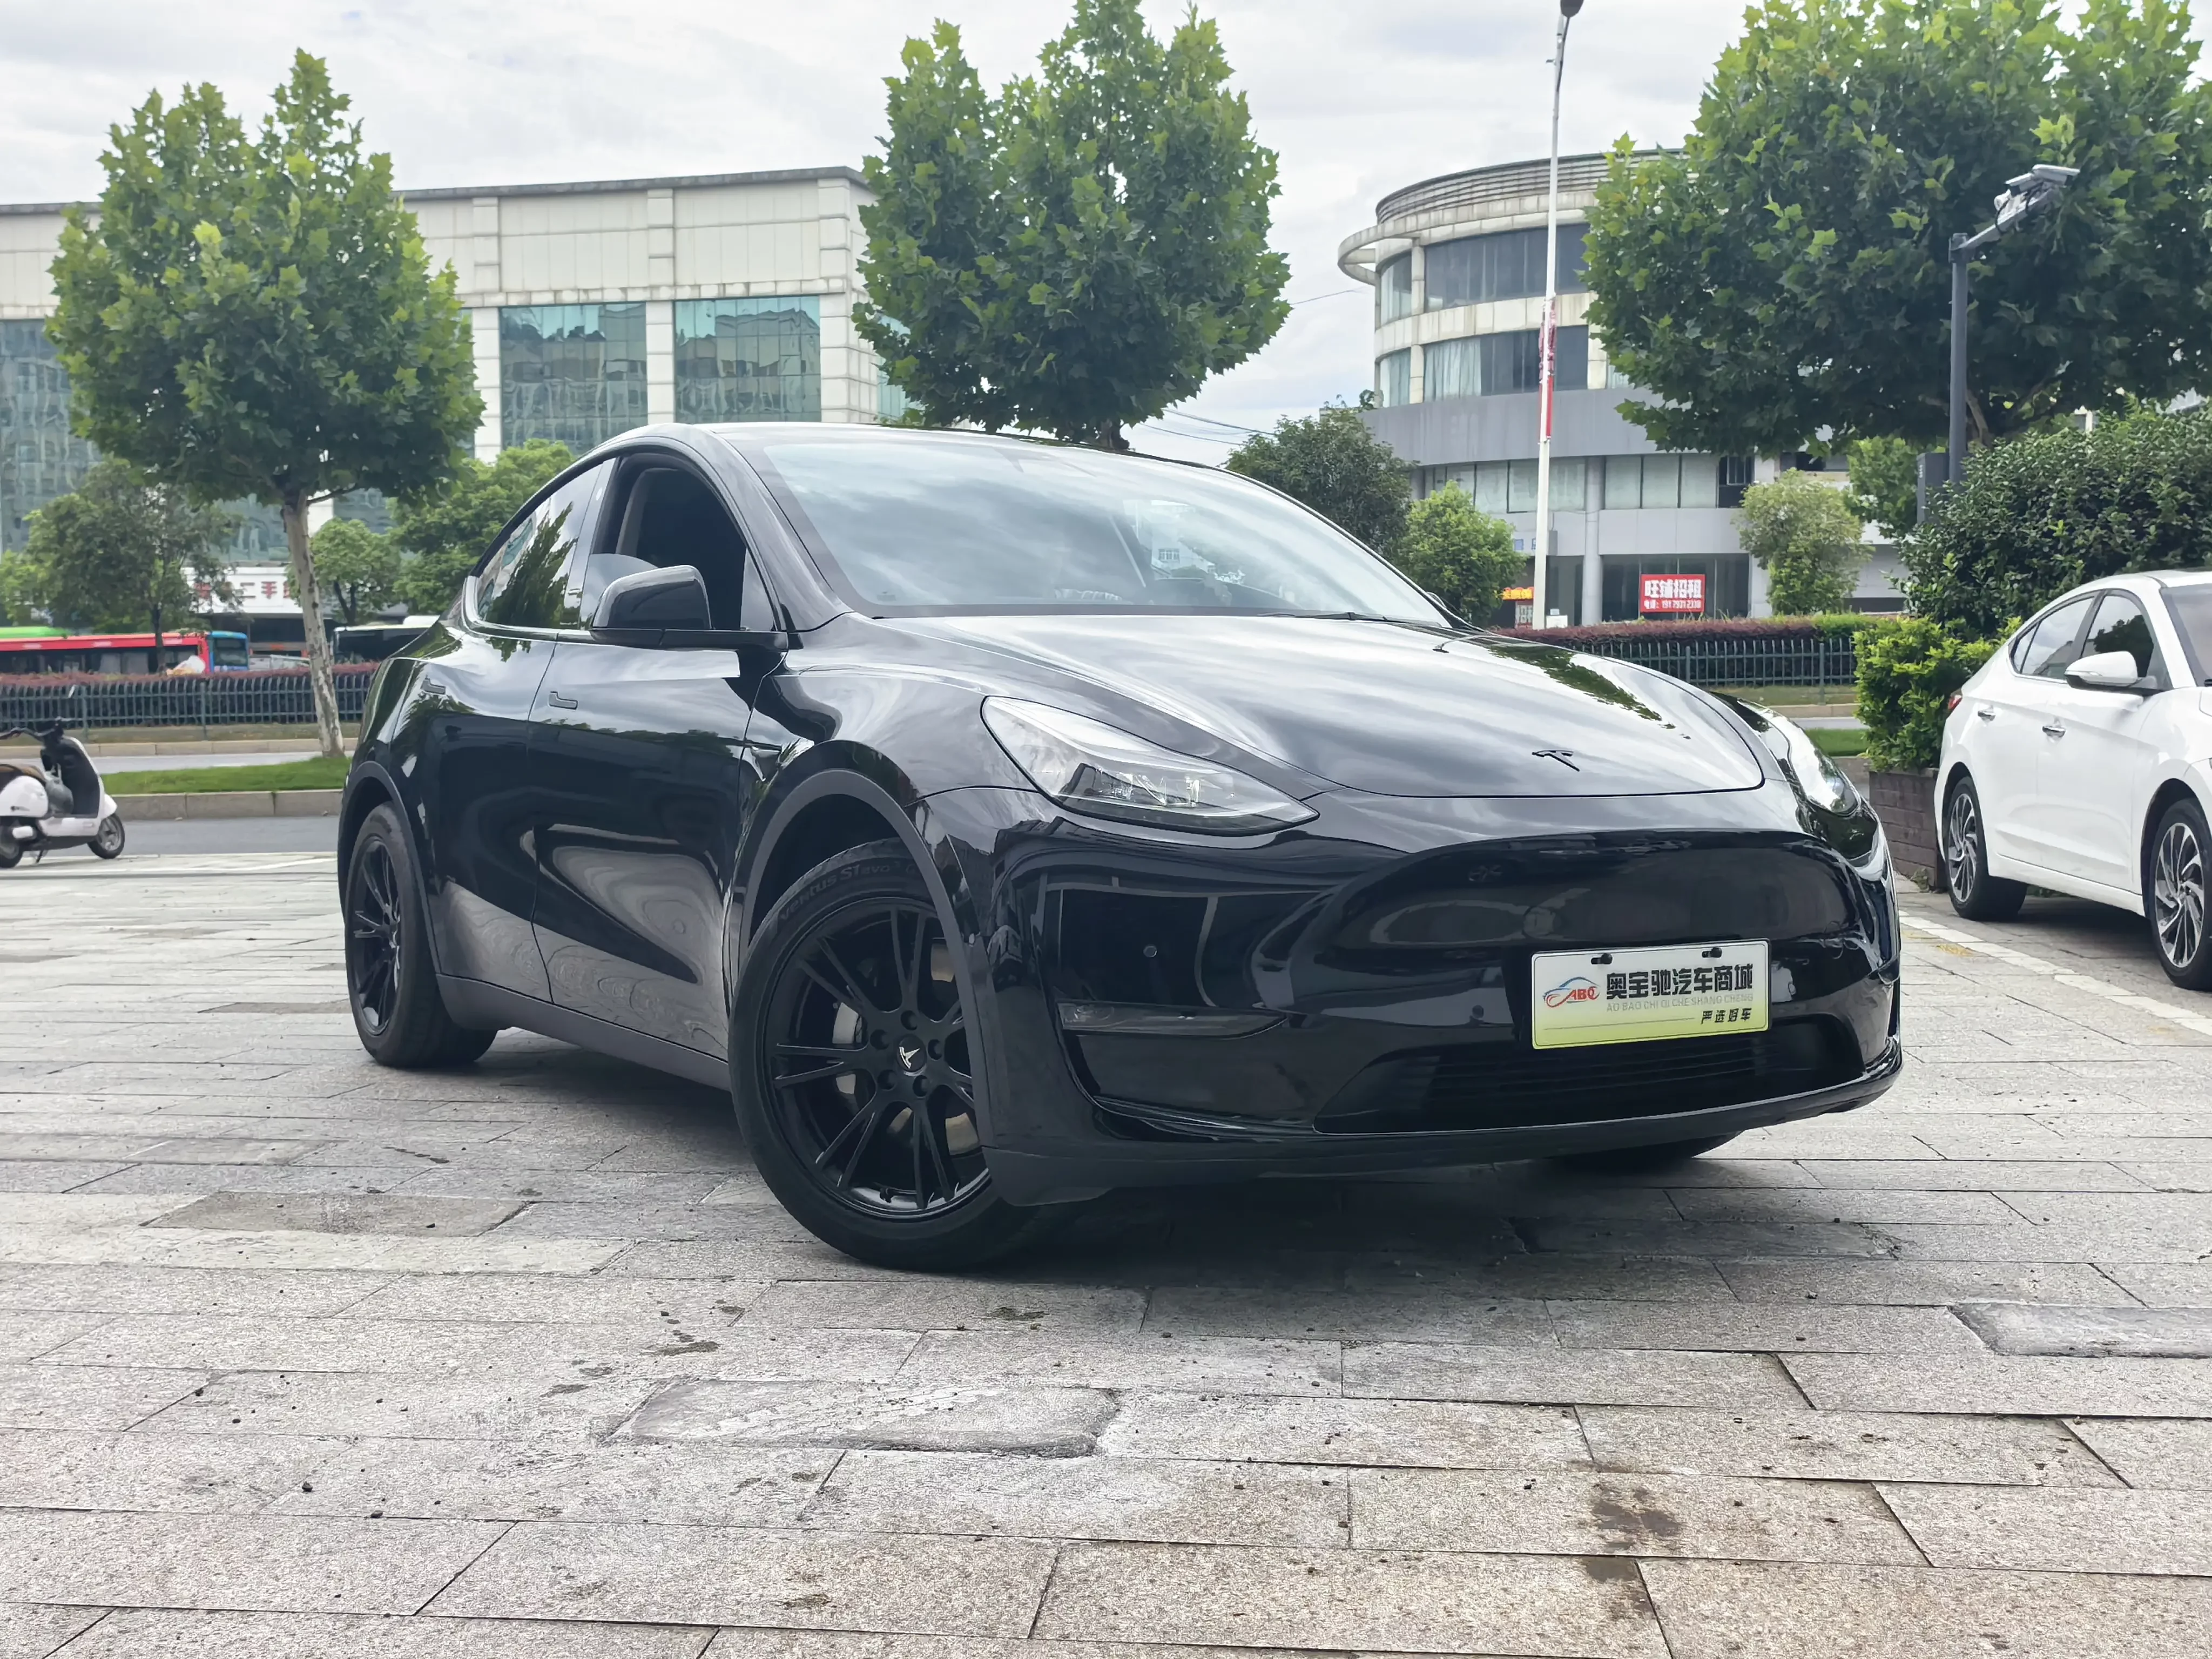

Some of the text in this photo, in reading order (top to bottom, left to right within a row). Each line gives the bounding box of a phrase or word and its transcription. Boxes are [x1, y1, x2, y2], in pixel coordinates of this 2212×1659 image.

[1644, 579, 1702, 598] 旺铺招租
[1606, 963, 1753, 1000] 奥宝驰汽车商城
[1607, 1003, 1620, 1013] AO
[1622, 1001, 1641, 1011] BAO
[1644, 1000, 1658, 1010] CHI
[1672, 997, 1689, 1007] CHE
[1691, 995, 1722, 1005] SHANG
[1701, 1008, 1752, 1024] 严选好车
